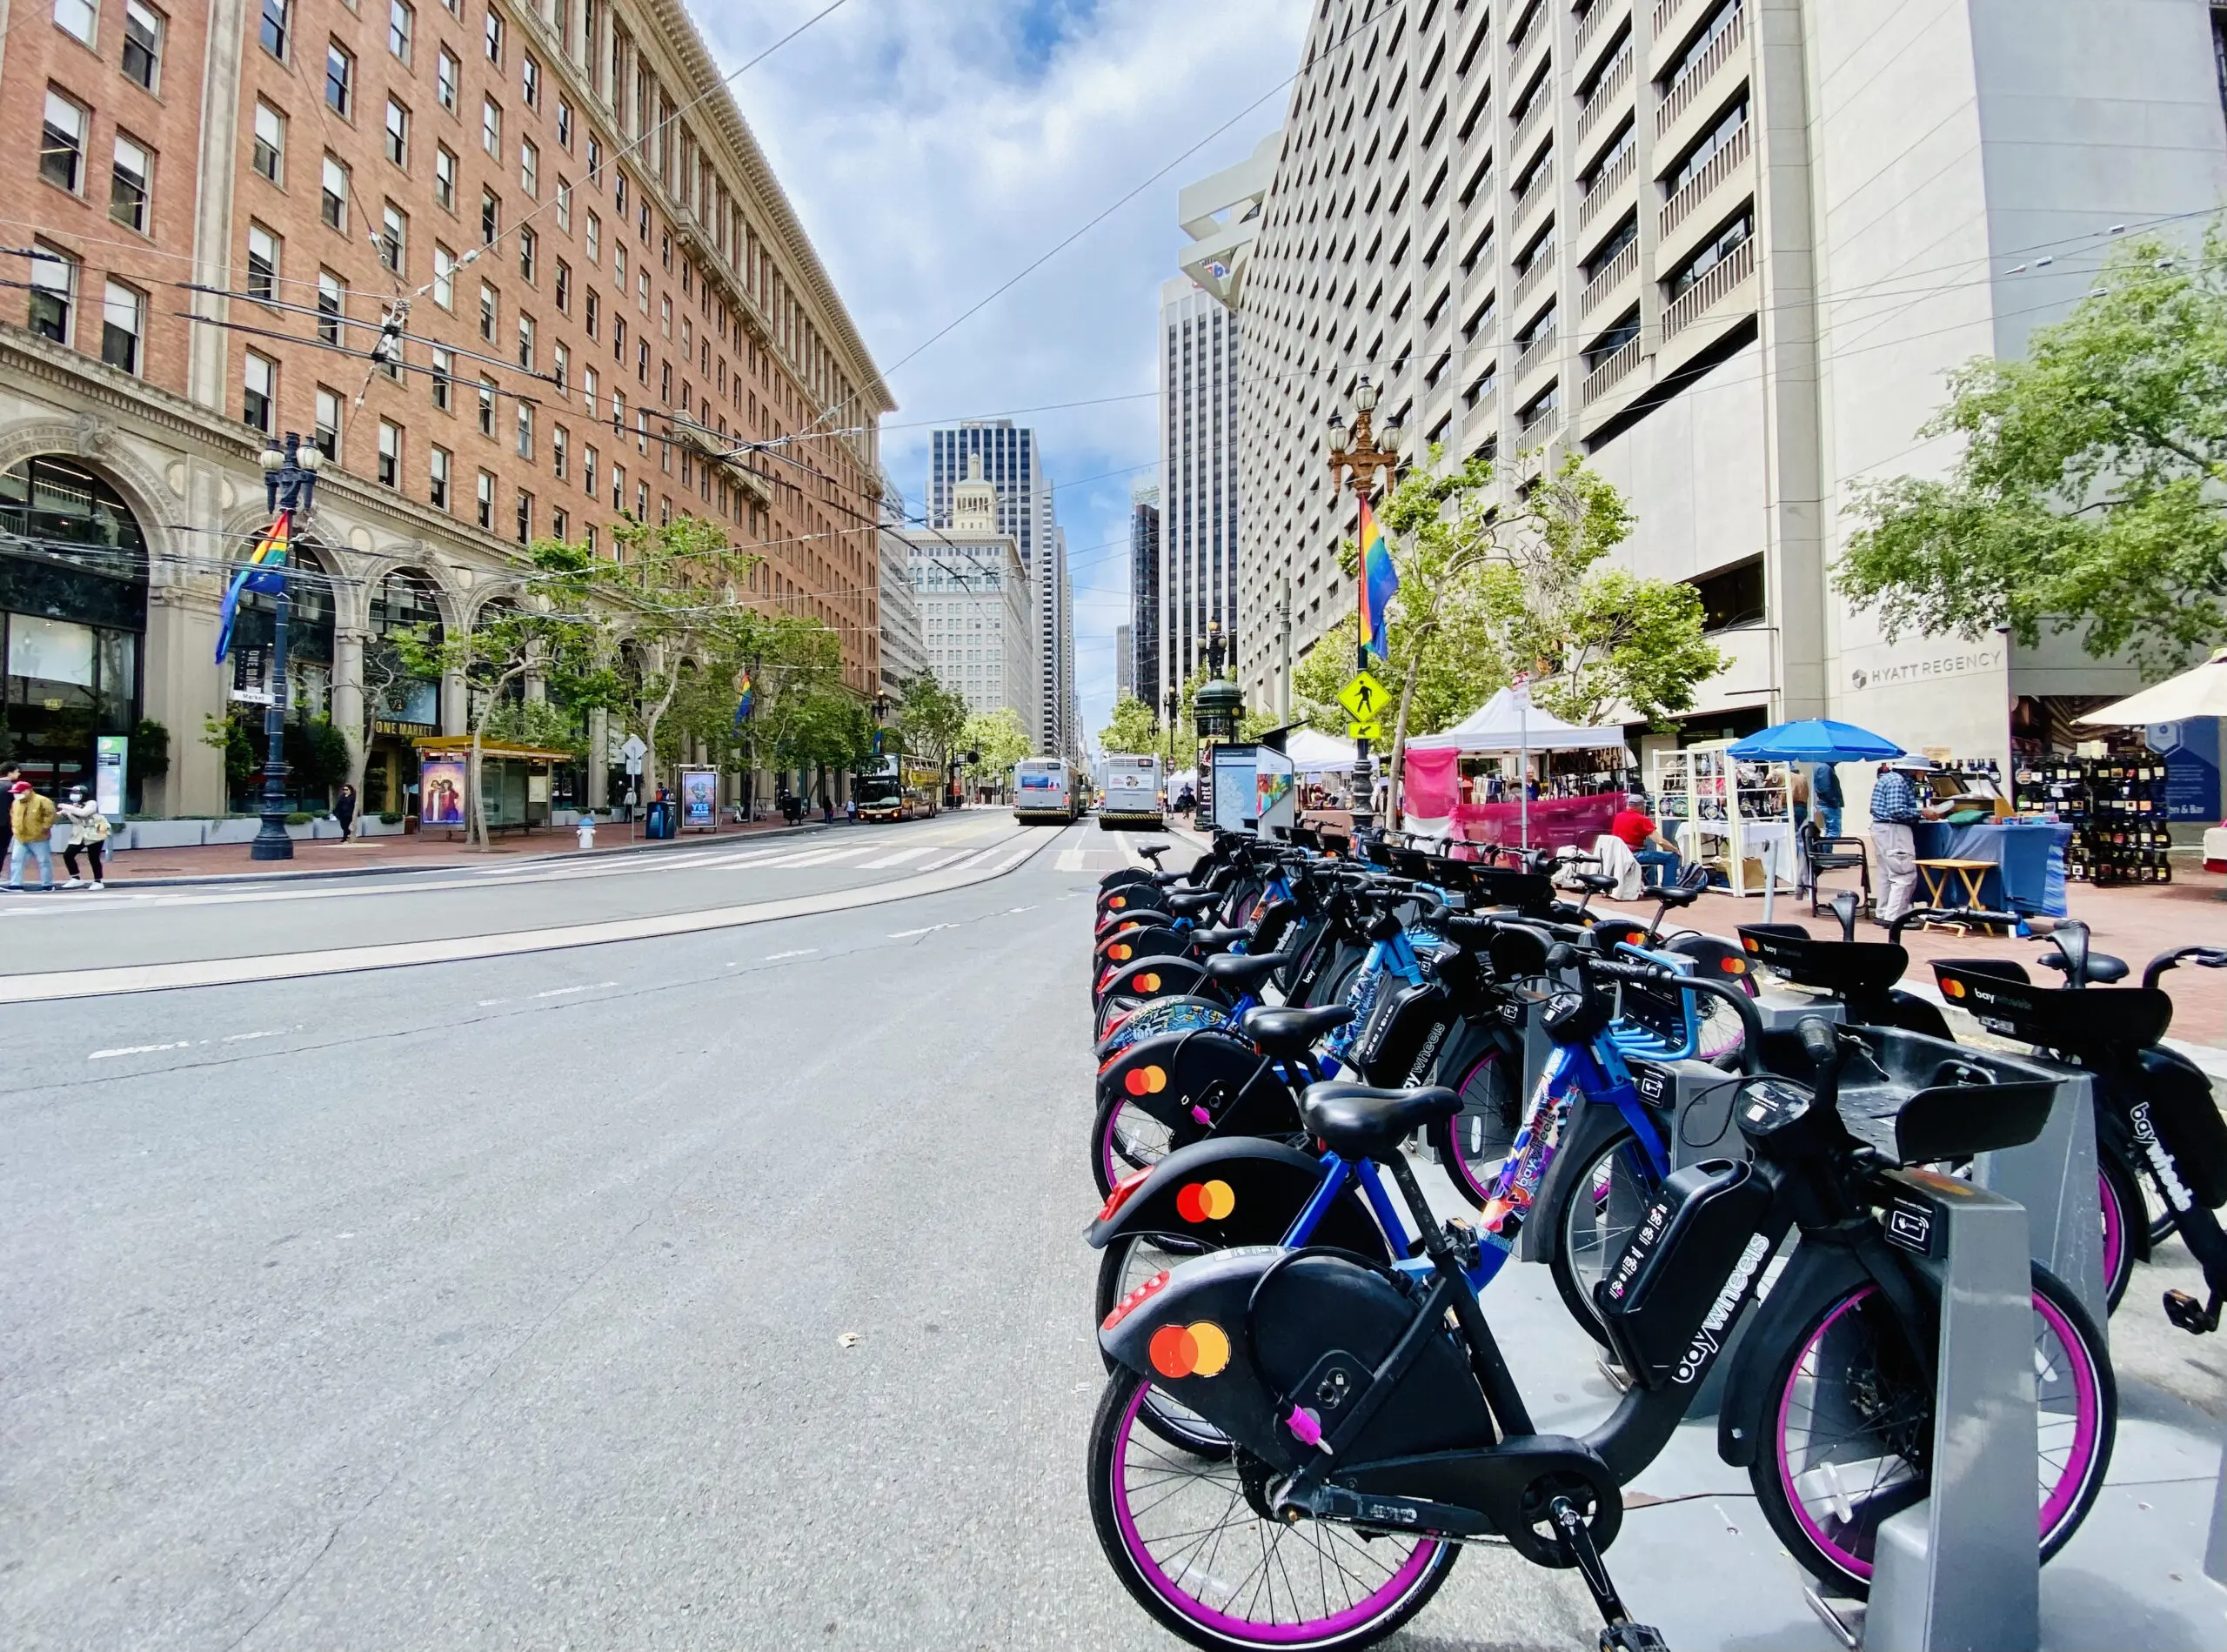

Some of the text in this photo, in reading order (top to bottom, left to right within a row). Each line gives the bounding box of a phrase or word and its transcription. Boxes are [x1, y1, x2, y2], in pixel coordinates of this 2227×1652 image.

[1871, 651, 2002, 683] HYATT REGENCY
[376, 720, 433, 737] ONE MARKET
[1402, 1022, 1447, 1089] aywheels
[2130, 1101, 2193, 1212] baywheels
[1671, 1232, 1770, 1384] baywheels
